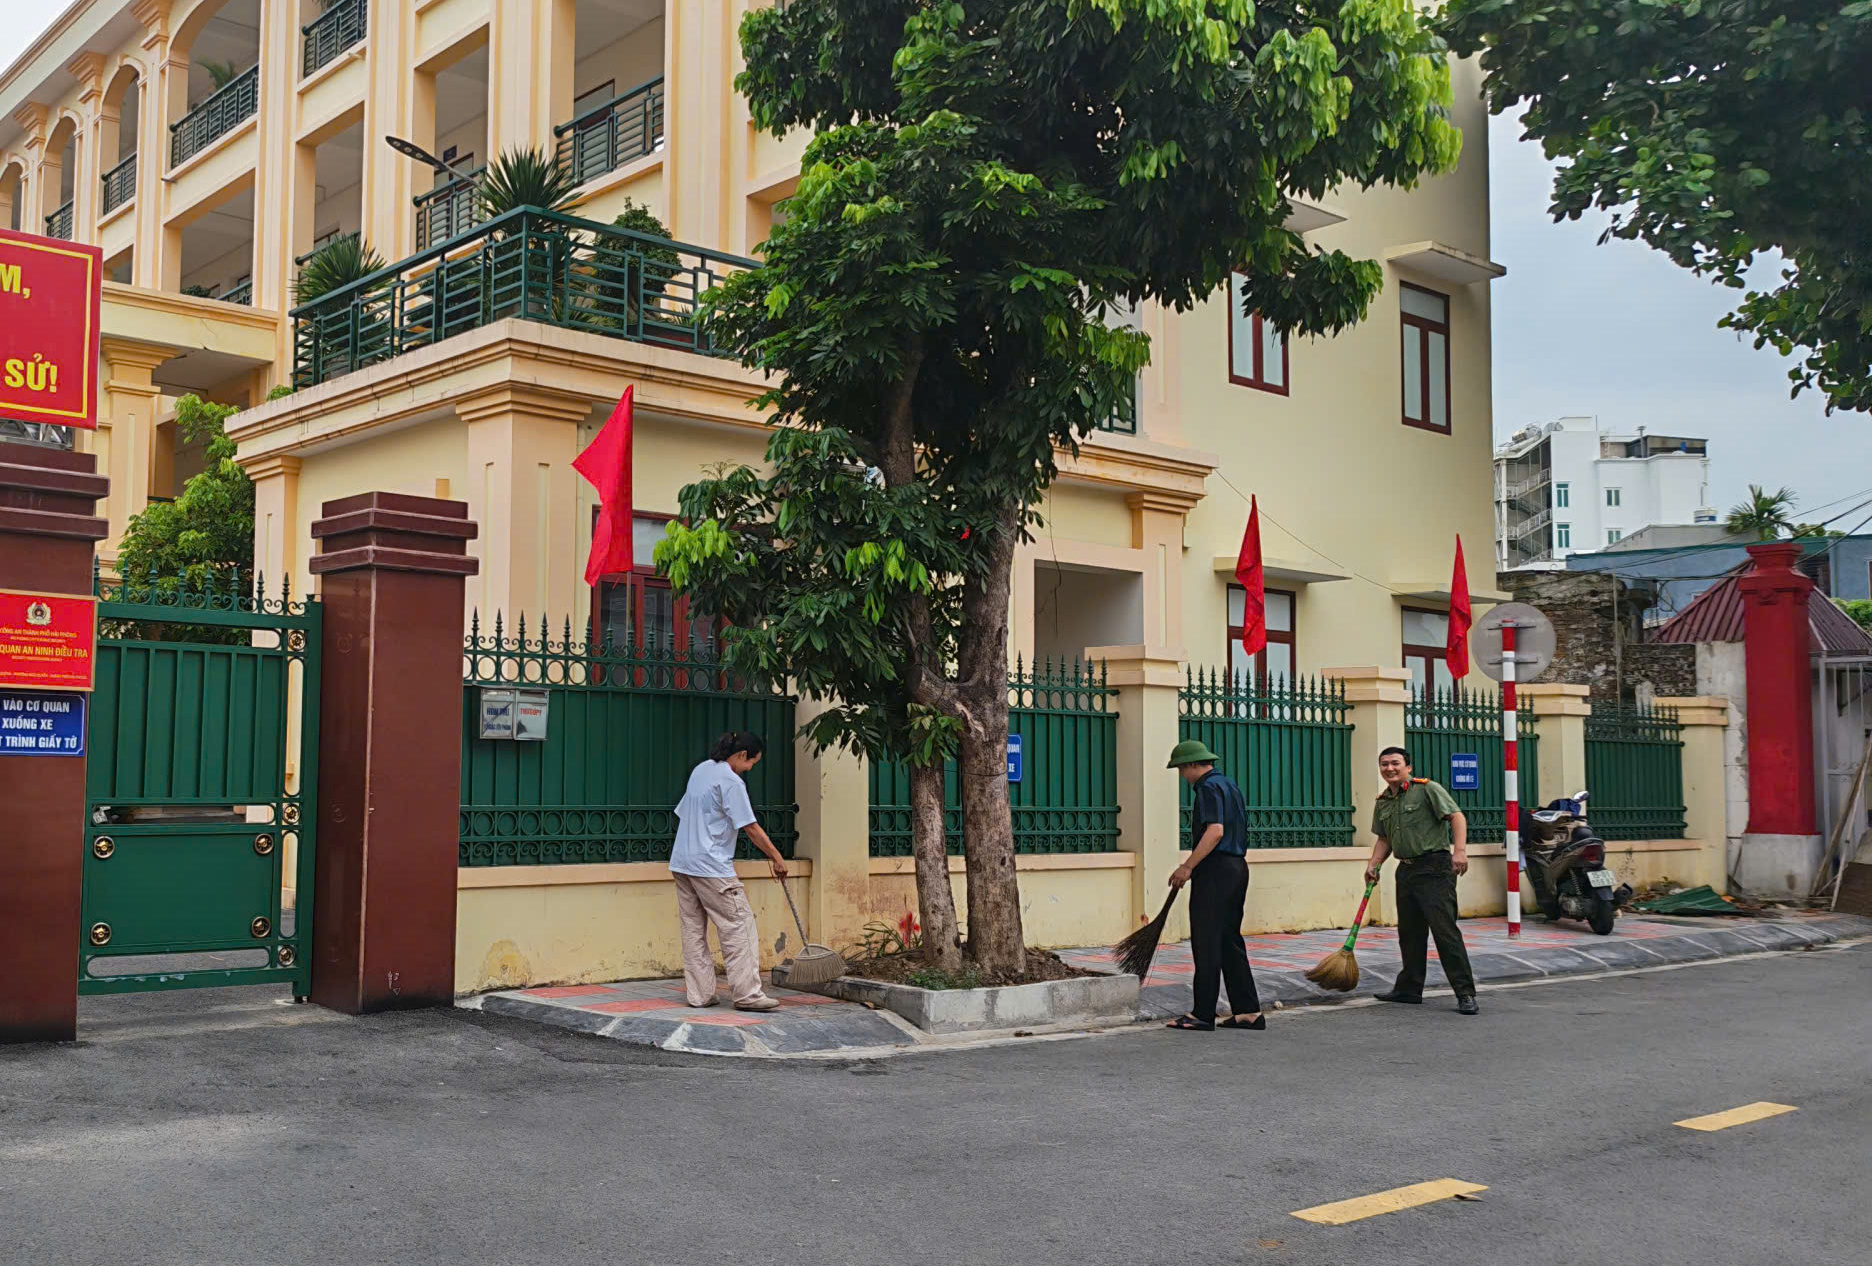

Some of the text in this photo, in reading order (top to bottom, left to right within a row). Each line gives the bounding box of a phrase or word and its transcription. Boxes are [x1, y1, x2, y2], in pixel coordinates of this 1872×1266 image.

[4, 352, 58, 393] SỬ!
[0, 644, 88, 658] QUAN AN NINH ĐIỀU TRA
[3, 698, 70, 713] VÀO CƠ QUAN
[2, 715, 53, 730] XUỐNG XE
[5, 734, 36, 747] TRÌNH
[38, 733, 62, 748] GIẤY
[64, 735, 78, 749] TỜ
